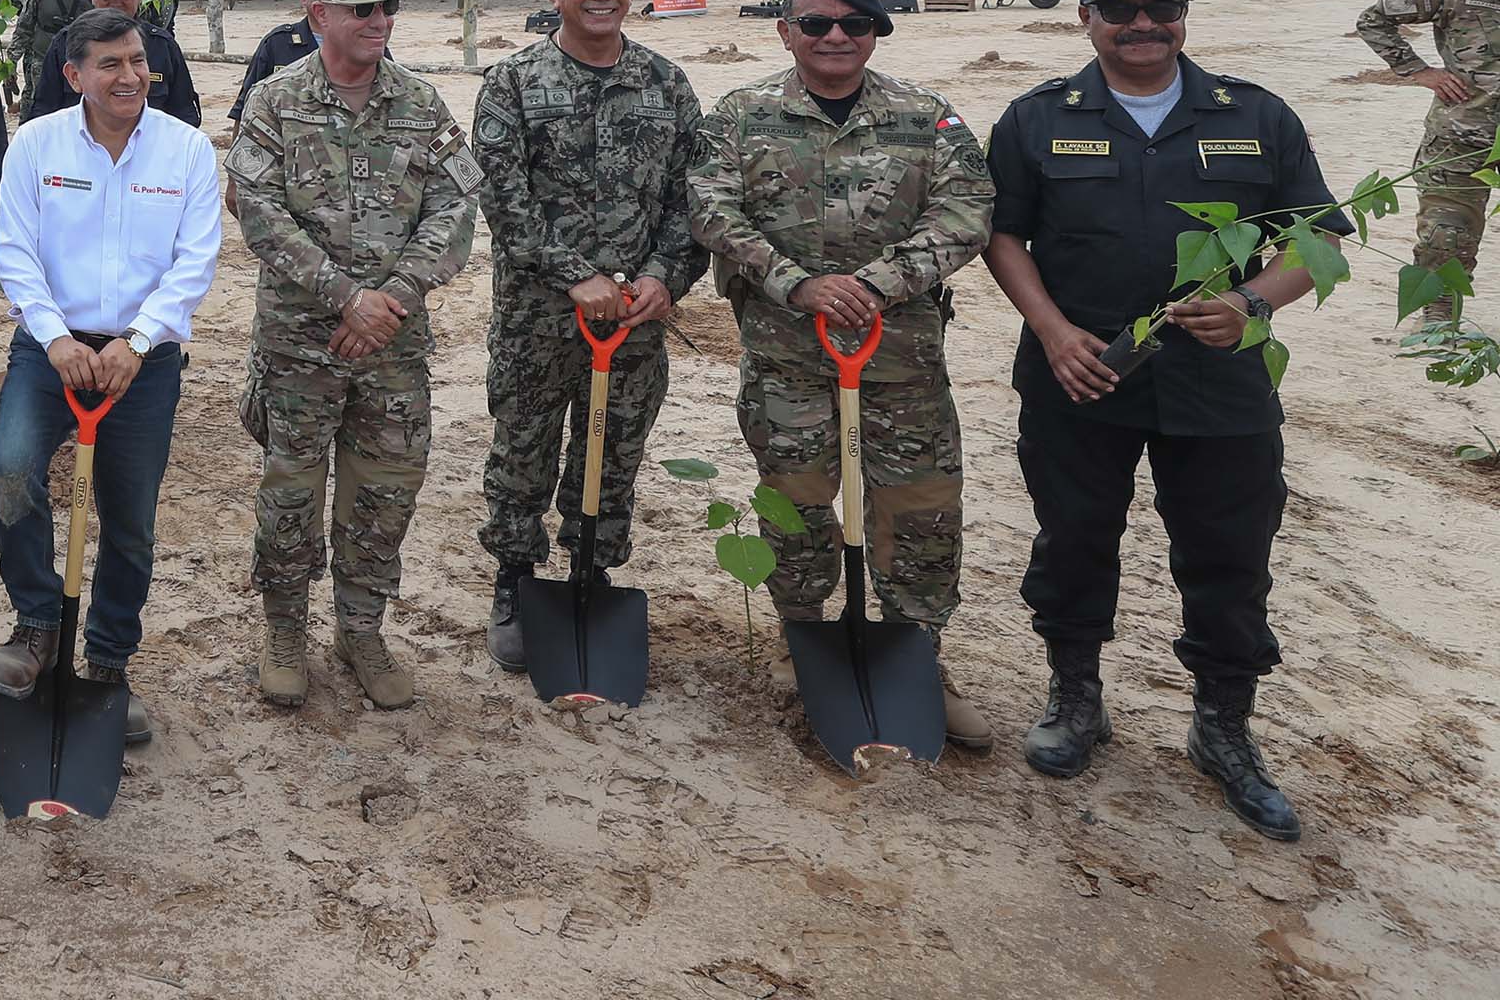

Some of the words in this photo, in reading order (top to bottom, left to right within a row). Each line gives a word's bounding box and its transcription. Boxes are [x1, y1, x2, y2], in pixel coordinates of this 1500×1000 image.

[750, 127, 801, 136] ASTUDILLO
[595, 412, 603, 434] TITAN
[850, 430, 858, 453] TITAN
[77, 480, 86, 504] TITAN
